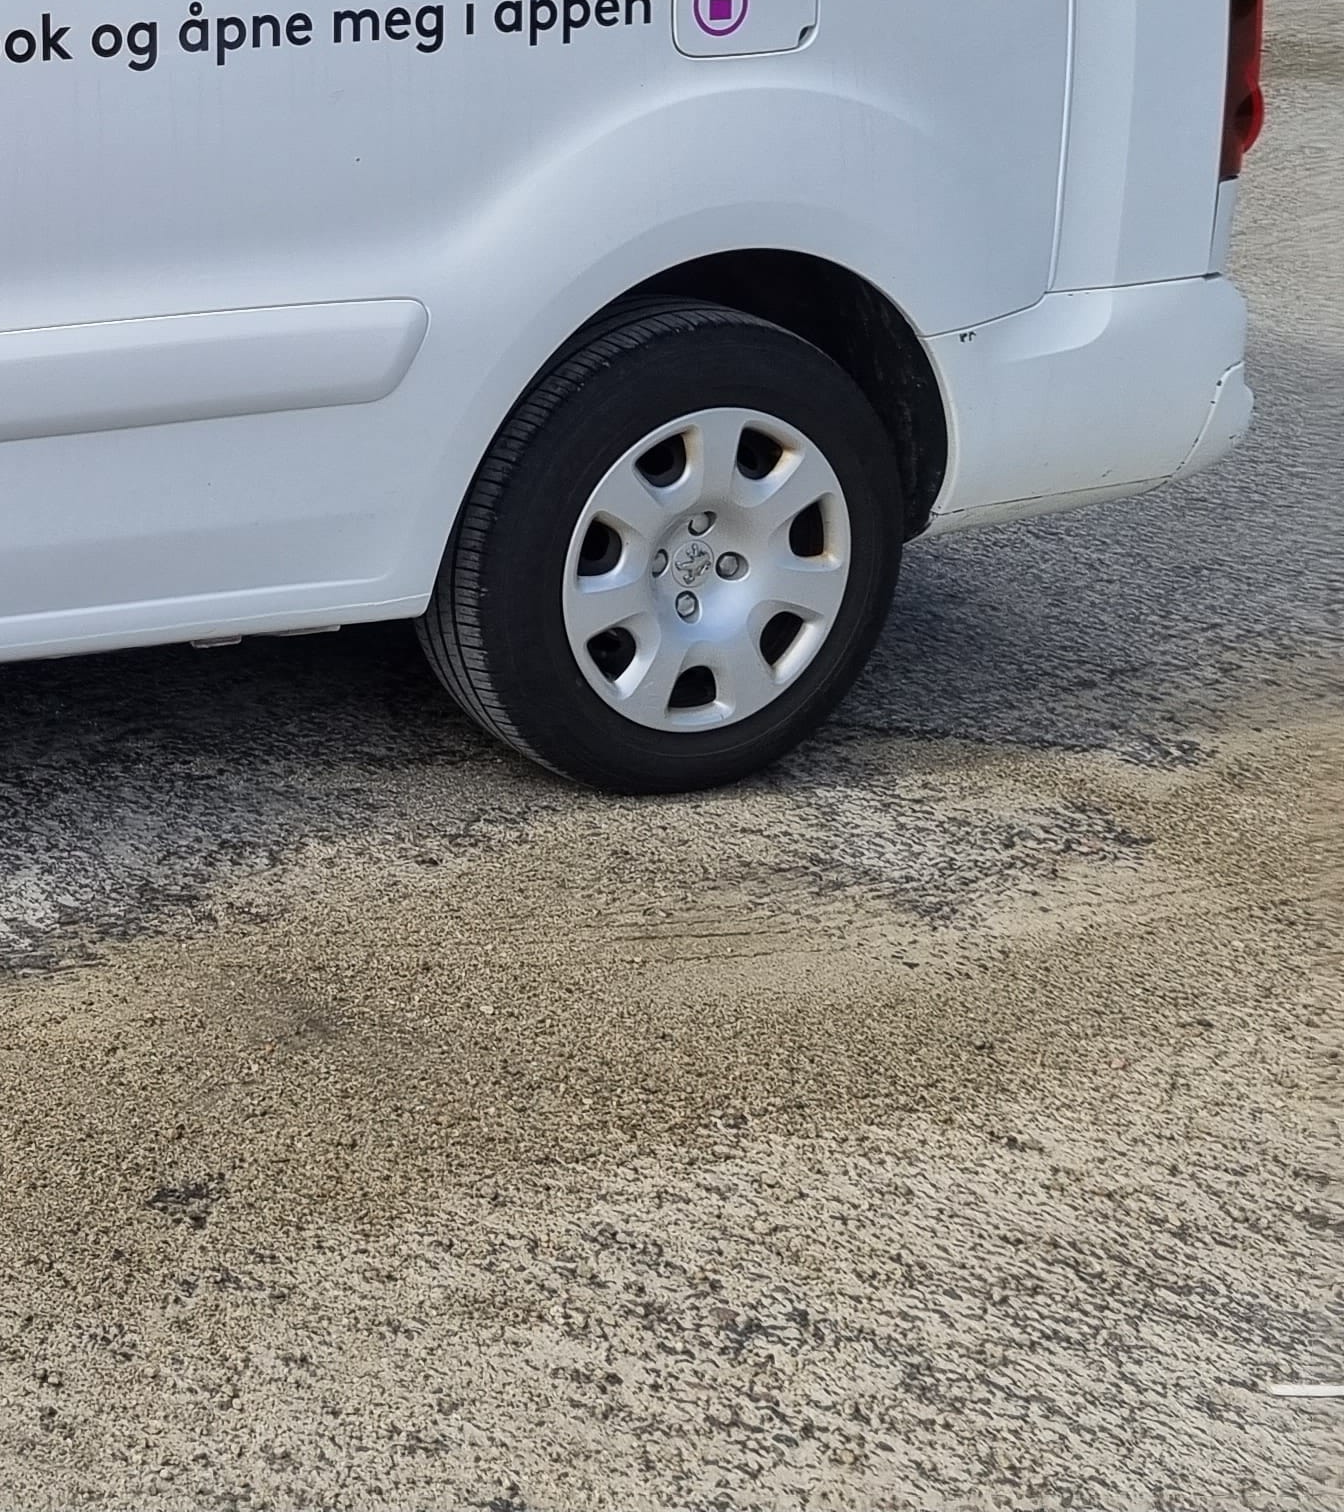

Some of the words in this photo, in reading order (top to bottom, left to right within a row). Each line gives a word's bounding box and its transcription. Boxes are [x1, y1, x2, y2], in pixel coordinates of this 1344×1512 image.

[92, 22, 158, 72] og
[178, 1, 313, 67] åpne
[333, 4, 444, 54] meg
